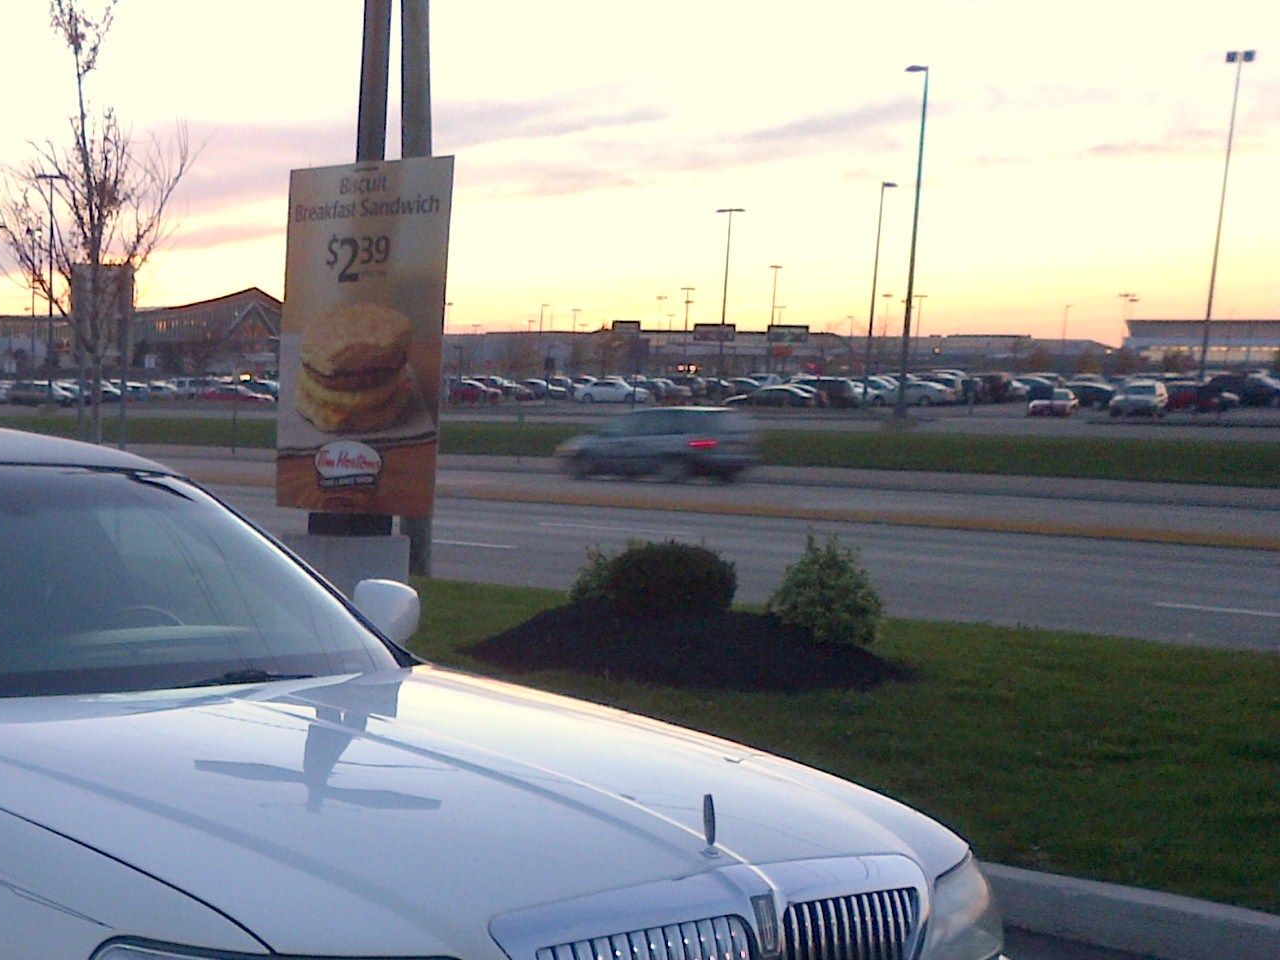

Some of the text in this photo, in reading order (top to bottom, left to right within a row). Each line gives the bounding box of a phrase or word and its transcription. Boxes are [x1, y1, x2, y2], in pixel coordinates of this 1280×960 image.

[339, 176, 388, 195] Biscuit
[295, 194, 441, 223] Breakfast Sandwich
[318, 448, 335, 468] Tim
